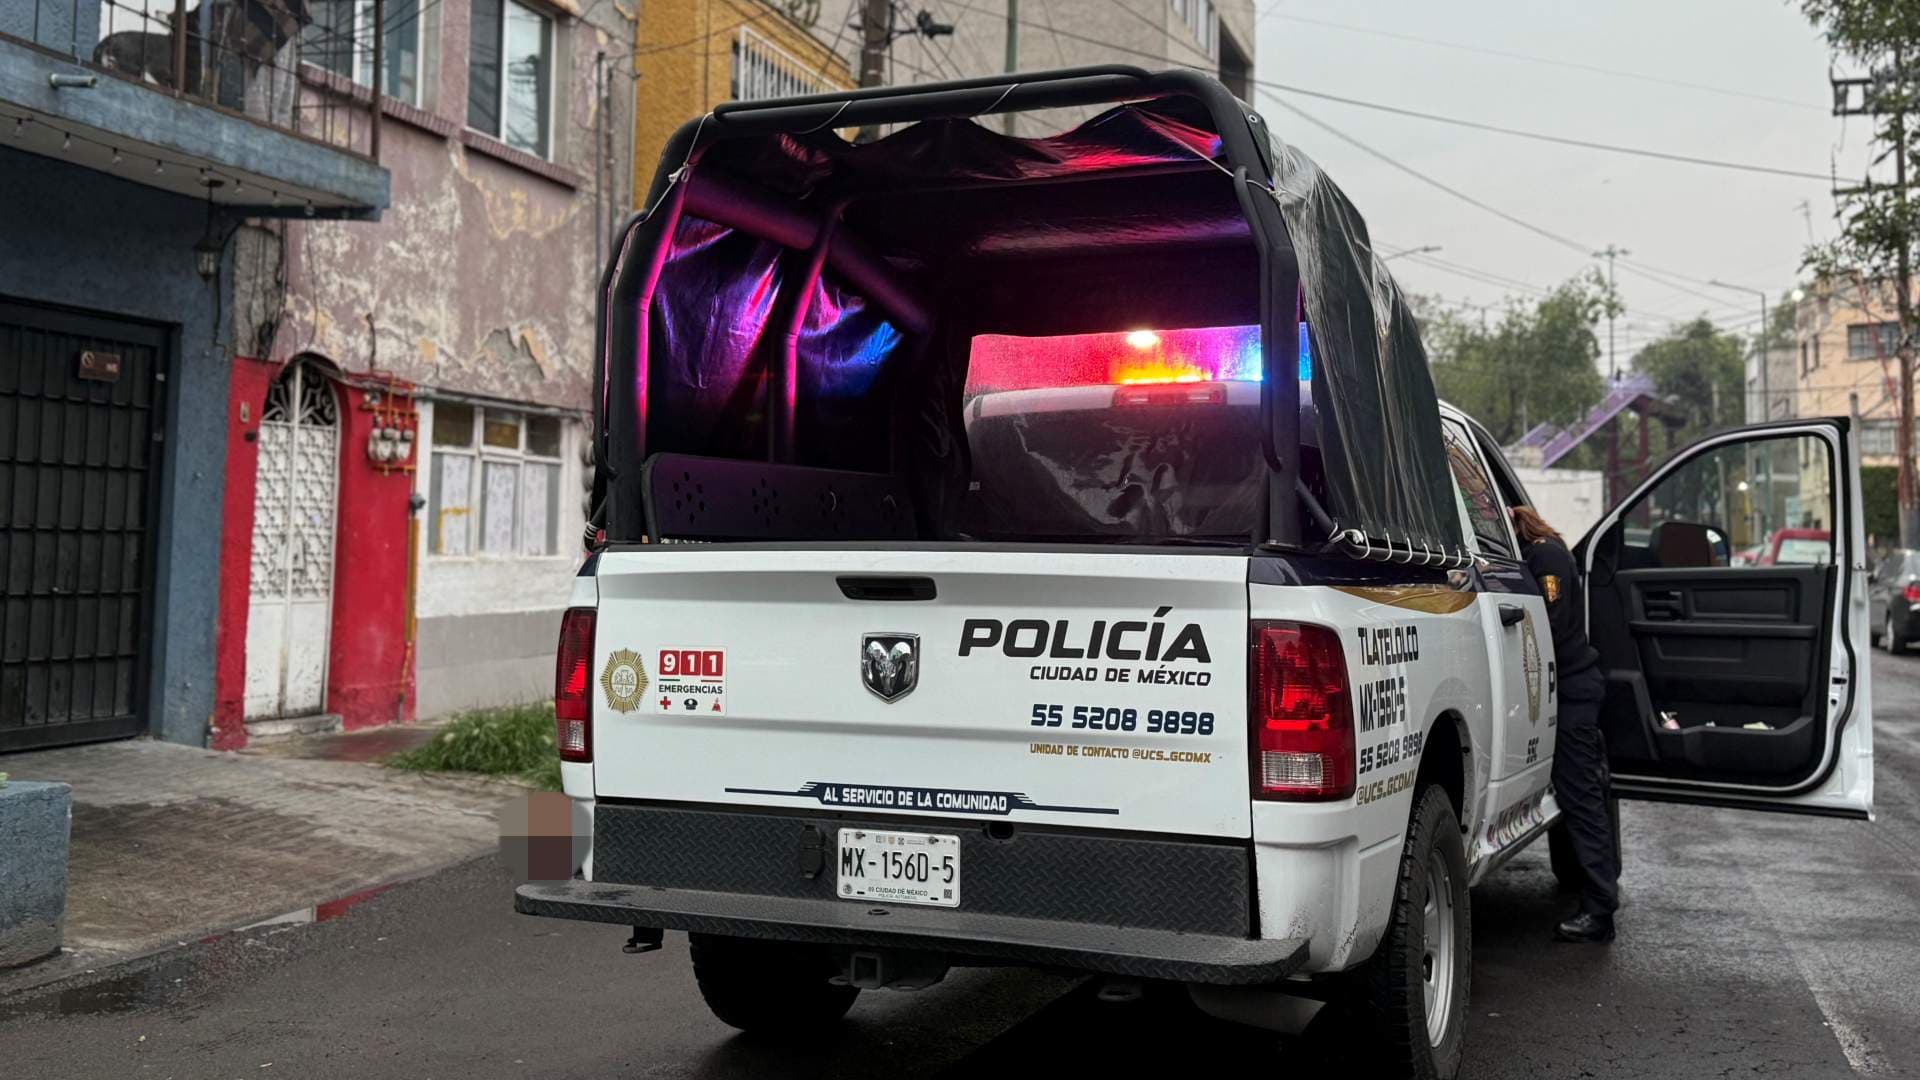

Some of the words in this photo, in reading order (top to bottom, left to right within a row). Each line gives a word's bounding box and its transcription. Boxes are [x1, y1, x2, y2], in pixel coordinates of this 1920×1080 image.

[958, 606, 1211, 663] POLICÍA
[1357, 625, 1418, 666] TLATELOLCO
[663, 653, 718, 673] 911
[1030, 666, 1097, 682] CIUDAD
[1104, 668, 1130, 683] DE
[1137, 665, 1211, 686] MÉXICO
[658, 685, 723, 694] EMERGENCIAS
[1360, 676, 1405, 733] MX-156D-5
[1031, 704, 1063, 727] 55
[1072, 706, 1136, 731] 5208
[1147, 709, 1214, 735] 9898
[1030, 743, 1063, 755] UNIDAD
[1066, 745, 1079, 756] DE
[1082, 746, 1129, 759] CONTACTO
[1132, 749, 1211, 763] @UCS_GCDMX
[1359, 746, 1373, 774] 55
[1376, 738, 1400, 769] 5208
[1402, 730, 1422, 760] 9898
[823, 787, 838, 802] AL
[842, 788, 894, 805] SERVICIO
[898, 791, 914, 806] DE
[917, 792, 933, 808] LA
[936, 793, 1007, 811] COMUNIDAD
[1356, 768, 1416, 806] @UCS_GCDMX
[841, 847, 954, 884] MX-156D-5
[876, 886, 896, 894] CIUDAD
